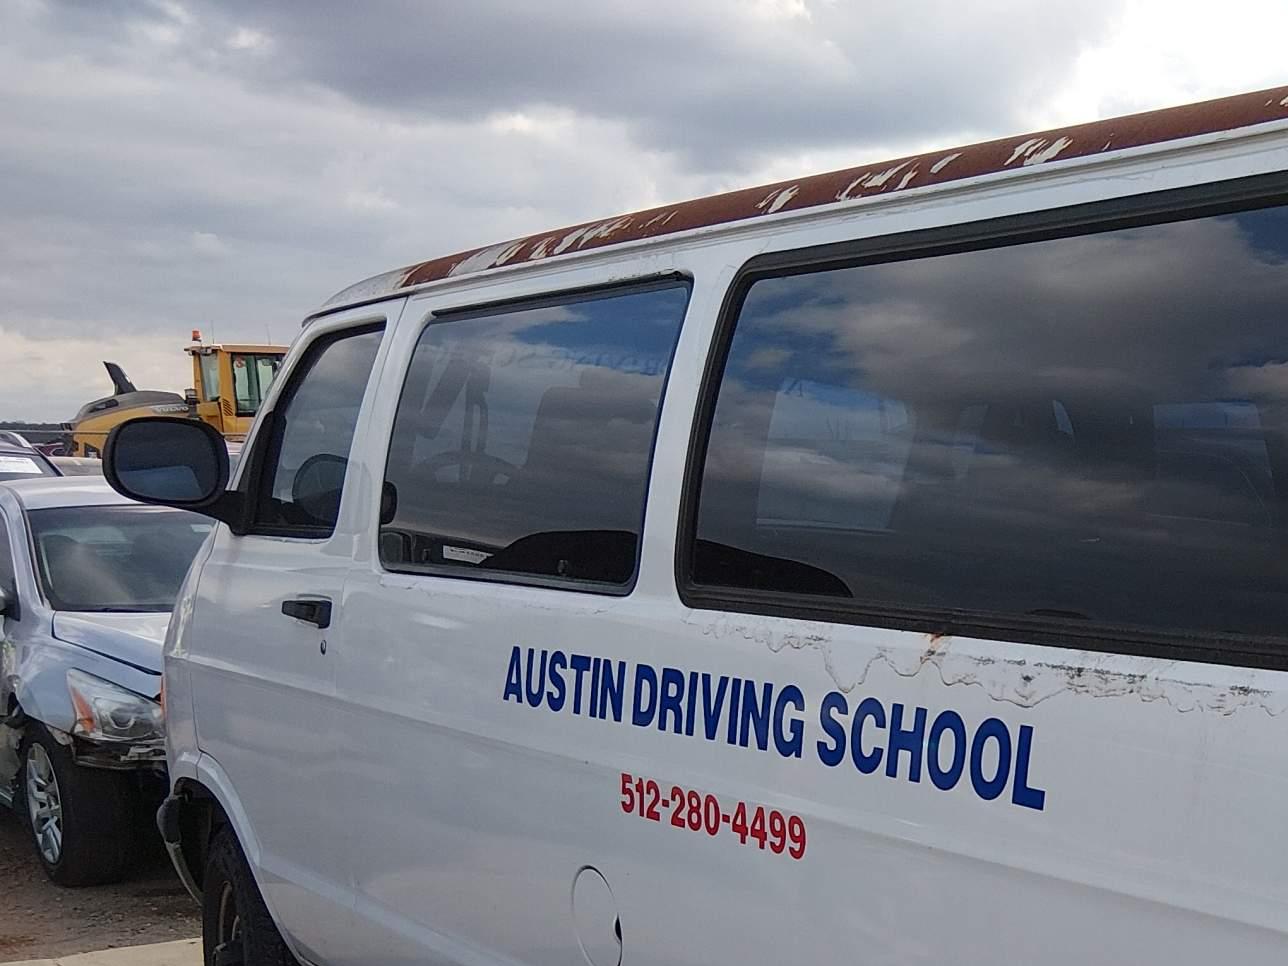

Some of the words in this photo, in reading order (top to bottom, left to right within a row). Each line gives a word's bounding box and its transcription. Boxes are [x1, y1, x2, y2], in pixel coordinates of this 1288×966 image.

[503, 646, 626, 722] AUSTIN
[632, 664, 804, 758] DRIVING
[816, 691, 1046, 811] SCHOOL
[620, 773, 806, 860] 512-280-4499
